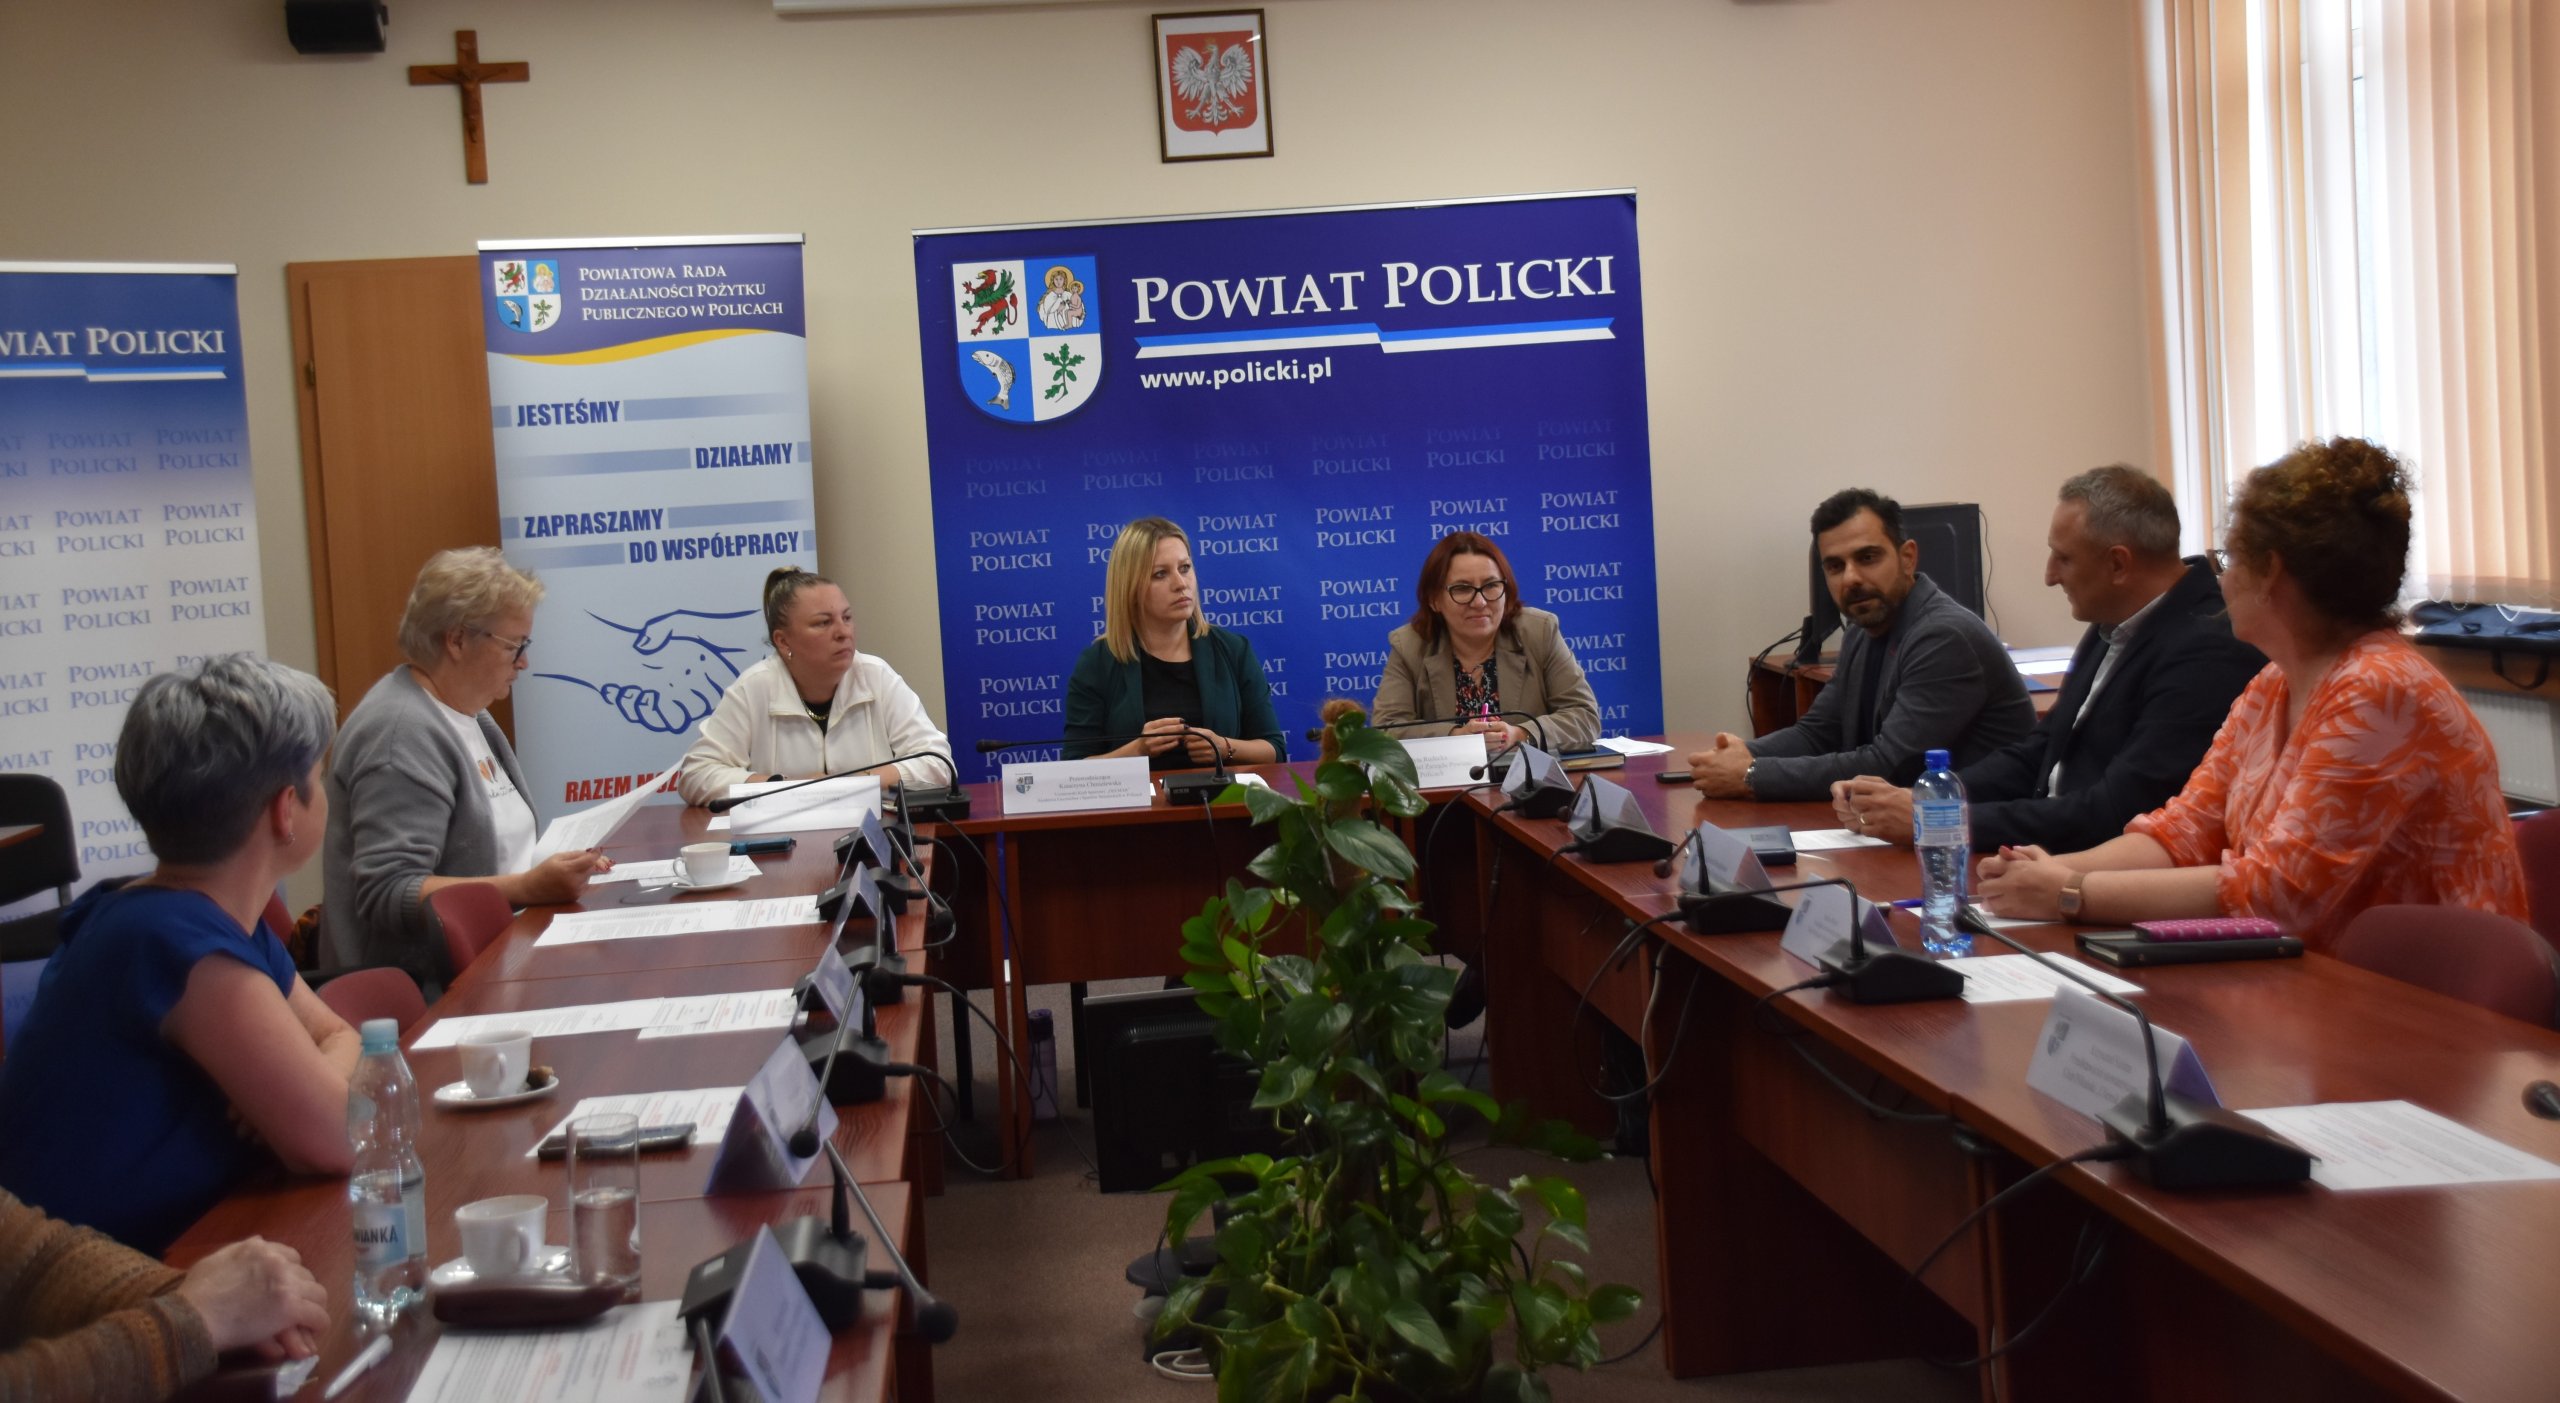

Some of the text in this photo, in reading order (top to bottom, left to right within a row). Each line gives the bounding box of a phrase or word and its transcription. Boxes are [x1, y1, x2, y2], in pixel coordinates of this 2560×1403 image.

[579, 264, 727, 282] POWIATOWA RADA
[581, 282, 766, 302] DZIAŁALNOŚCI POŻYTKU
[1131, 256, 1615, 324] POWIAT POLICKI
[582, 302, 784, 321] PUBLICZNEGO W POLICACH
[86, 327, 226, 355] POLICKI
[1140, 356, 1333, 389] www.policki.pl
[517, 397, 621, 427] JESTEŚMY
[156, 429, 236, 446] POWIAT
[695, 442, 793, 469] DZIAŁAMY
[1427, 449, 1505, 468] POLICKI
[1537, 442, 1616, 460] POLICKI
[158, 452, 238, 470] POLICKI
[1312, 457, 1392, 475] POLICKI
[1084, 472, 1163, 491] POLICKI
[1195, 465, 1275, 483] POLICKI
[966, 479, 1047, 498] POLICKI
[1430, 498, 1508, 516] POWIAT
[1540, 490, 1618, 509] POWIAT
[55, 508, 142, 528] POWIAT
[163, 503, 243, 522] POWIAT
[1315, 505, 1394, 524] POWIAT
[524, 508, 664, 538] ZAPRASZAMY
[1198, 513, 1277, 532] POWIAT
[1541, 513, 1620, 532] POLICKI
[57, 533, 144, 553] POLICKI
[165, 527, 245, 546] POLICKI
[970, 528, 1050, 548] POWIAT
[1316, 529, 1396, 548] POLICKI
[629, 530, 799, 564] DO WSPÓŁPRACY
[1200, 537, 1279, 556] POLICKI
[971, 552, 1052, 572] POLICKI
[1544, 561, 1622, 581] POWIAT
[62, 585, 149, 605] POWIAT
[169, 577, 248, 597] POWIAT
[1203, 585, 1282, 605] POWIAT
[1320, 577, 1399, 597] POWIAT
[1545, 585, 1624, 605] POLICKI
[171, 601, 251, 621] POLICKI
[975, 602, 1055, 621] POWIAT
[1205, 609, 1284, 627] POLICKI
[1321, 601, 1400, 620] POLICKI
[0, 619, 43, 637] ICKI
[63, 610, 150, 631] POLICKI
[976, 625, 1057, 645] POLICKI
[1563, 633, 1626, 650] OWIAT
[1324, 651, 1388, 669] POWIA
[68, 661, 155, 683] POWIAT
[980, 675, 1060, 694] POWIAT
[1325, 674, 1383, 692] POLIC
[70, 687, 140, 709] POLIC
[980, 699, 1062, 718] POLICKI
[0, 750, 53, 770] WIAT
[985, 748, 1063, 767] POWIAT
[565, 775, 632, 803] RAZEM
[83, 841, 148, 864] POLIC
